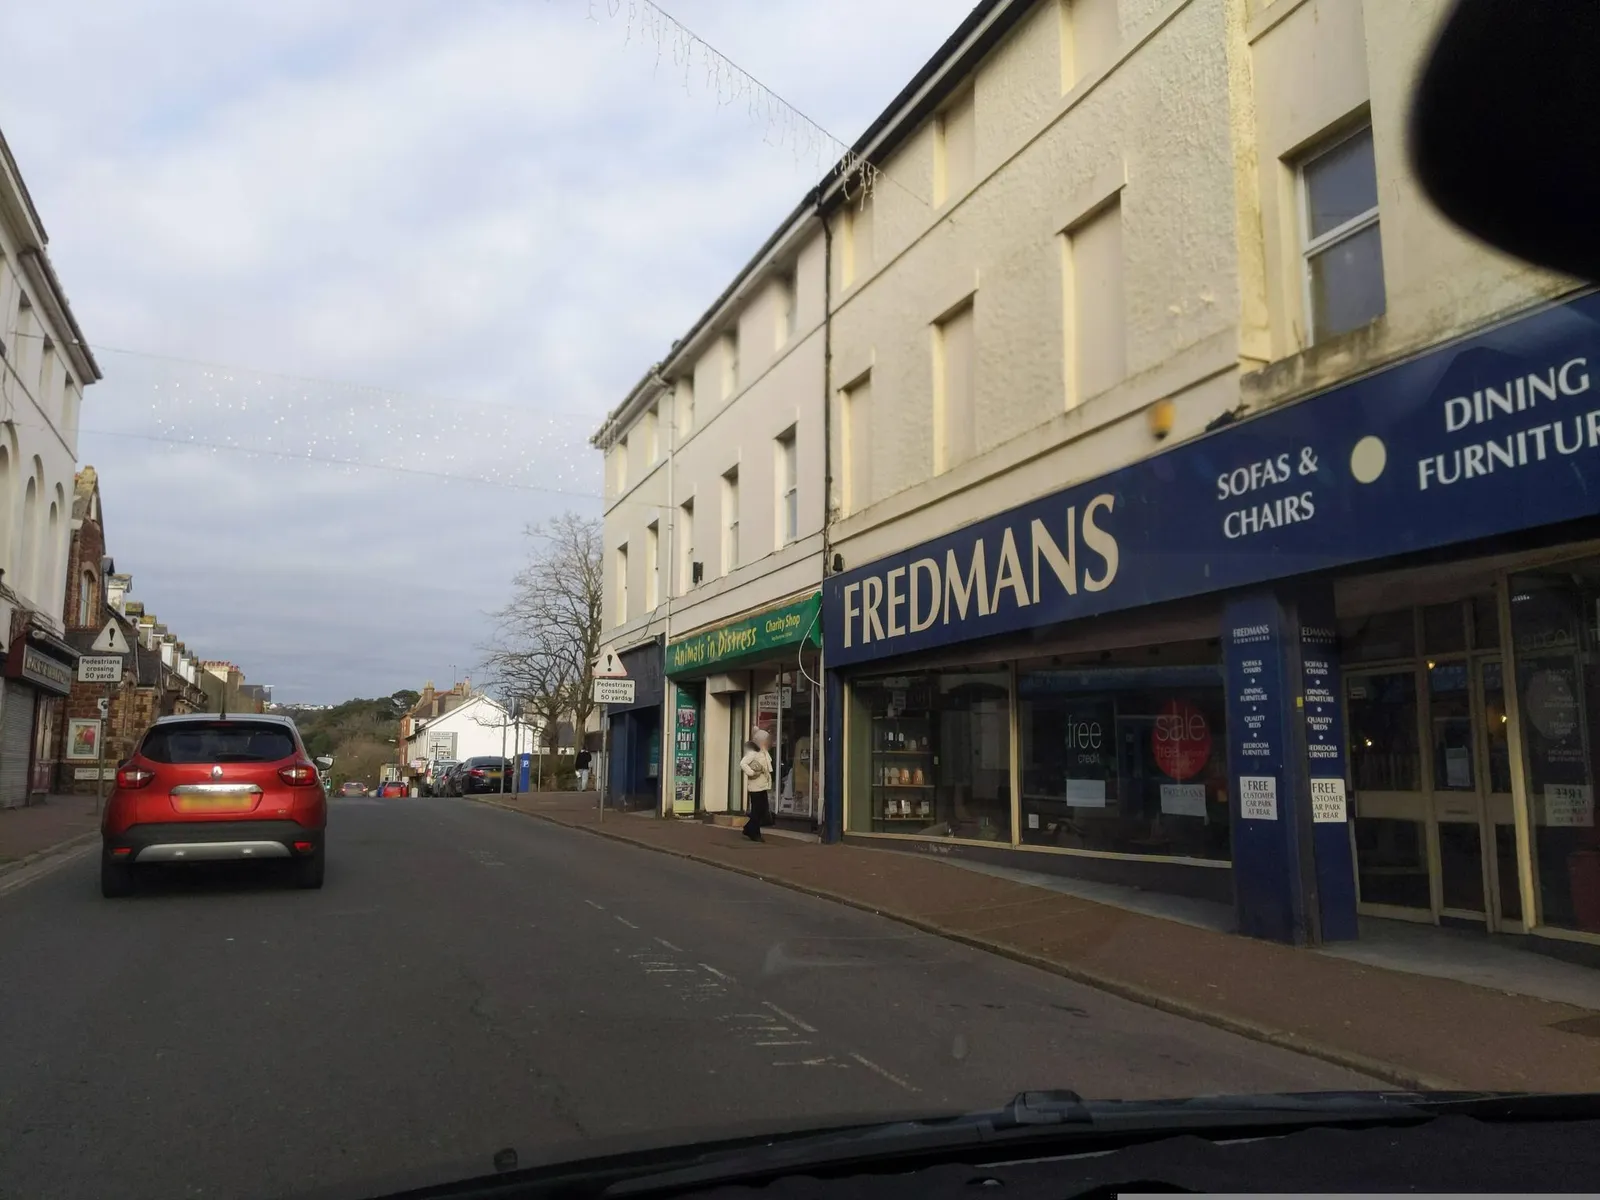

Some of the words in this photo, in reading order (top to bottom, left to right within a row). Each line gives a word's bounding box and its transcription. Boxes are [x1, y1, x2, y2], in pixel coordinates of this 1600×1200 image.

[1444, 357, 1590, 433] DINING
[1417, 409, 1600, 491] FURNITUR
[1216, 453, 1291, 500] SOFAS
[1298, 446, 1319, 476] &
[1223, 491, 1316, 539] CHAIRS
[843, 493, 1119, 649] FREDMANS
[765, 617, 786, 634] Charity
[785, 613, 801, 629] Shop
[1233, 624, 1270, 637] FREDMANS
[674, 642, 704, 666] Animals
[707, 635, 715, 658] in
[718, 627, 757, 657] Distress
[86, 665, 114, 673] crossing
[1242, 660, 1258, 668] SOFAS
[1240, 694, 1268, 702] FURNITURE
[1305, 695, 1334, 703] URNITURE
[1156, 706, 1206, 742] sale
[1244, 715, 1265, 723] QUALITY
[1307, 716, 1333, 724] QUALITY
[1067, 713, 1102, 749] free
[1077, 753, 1100, 764] credit
[1247, 780, 1269, 791] FREE
[1312, 782, 1337, 794] FREE
[1243, 791, 1275, 799] CUSTOMER
[1314, 795, 1344, 803] STOMER
[1256, 808, 1271, 816] REAR
[1324, 803, 1341, 811] PARK
